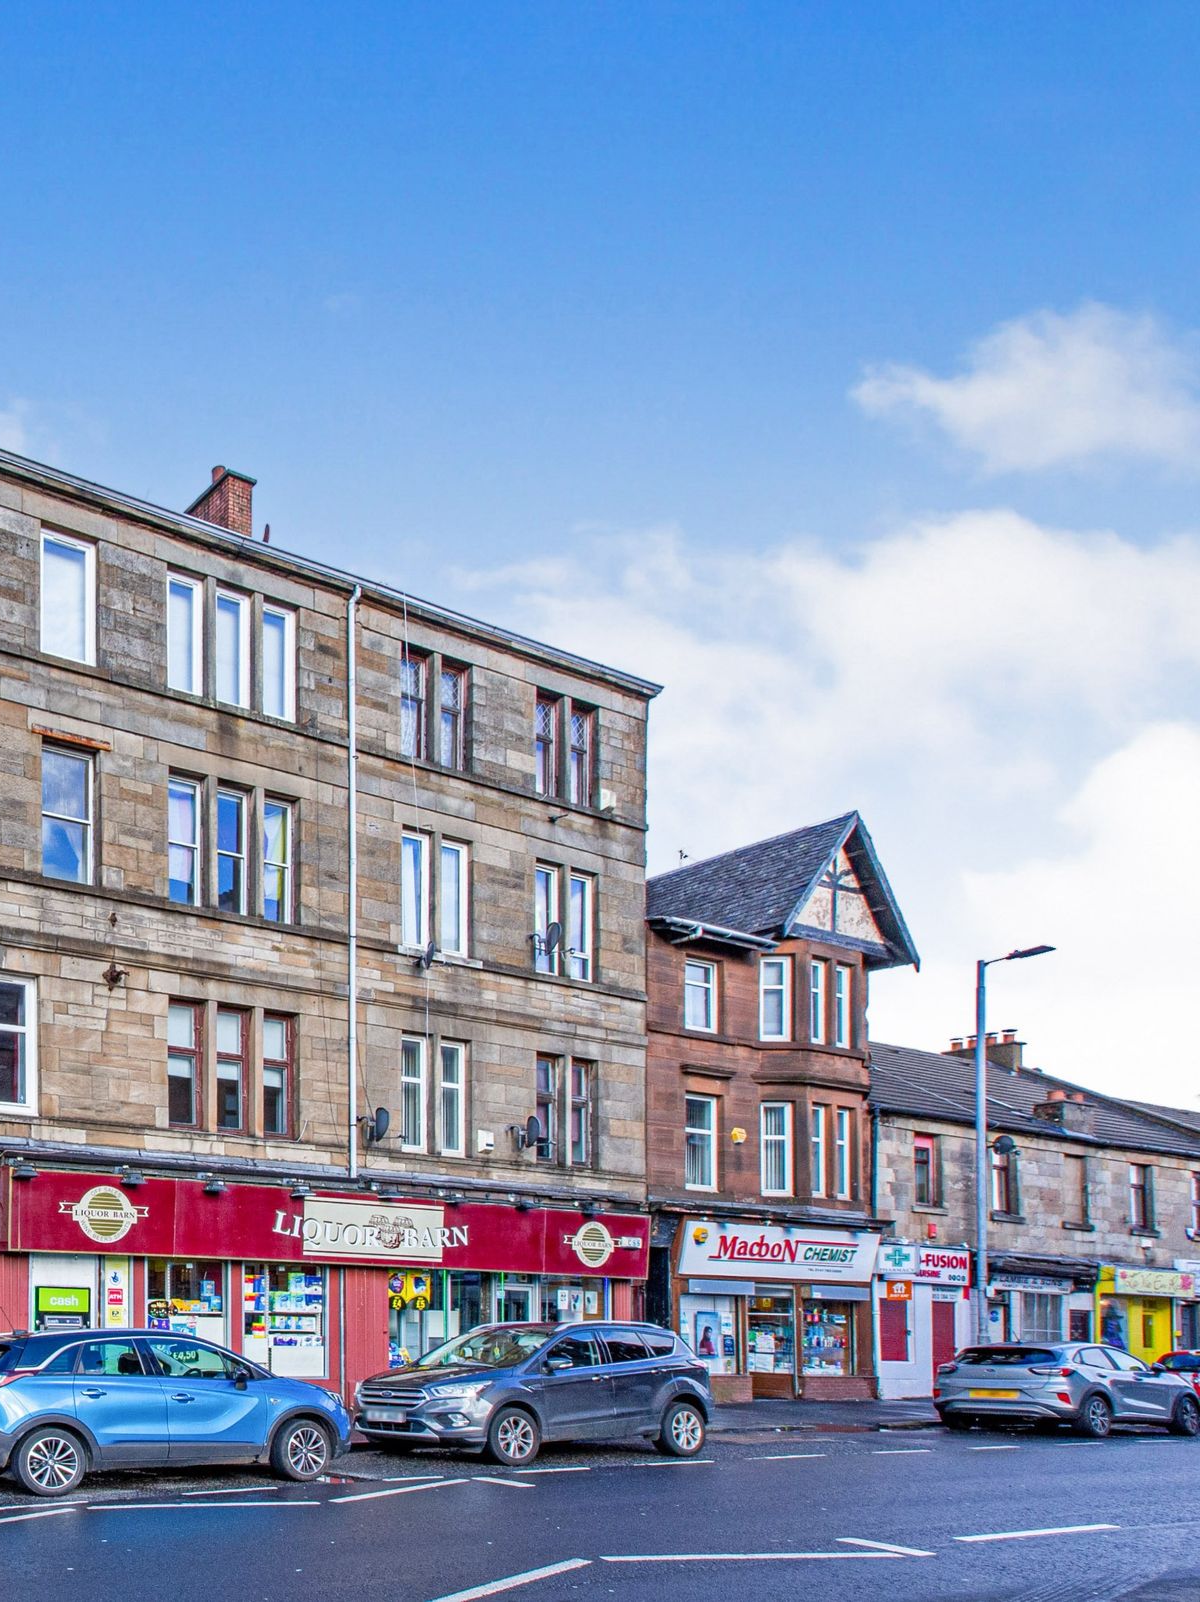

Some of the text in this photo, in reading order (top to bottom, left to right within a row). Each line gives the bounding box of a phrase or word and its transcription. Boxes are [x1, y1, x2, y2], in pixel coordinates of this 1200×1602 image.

[74, 1209, 135, 1219] LIQUOR BARN
[272, 1209, 469, 1249] LIQUOR BARN
[573, 1240, 596, 1248] LIQUOR
[803, 1247, 857, 1262] CHEMIST
[920, 1253, 968, 1269] -FUSION
[50, 1295, 79, 1307] cash
